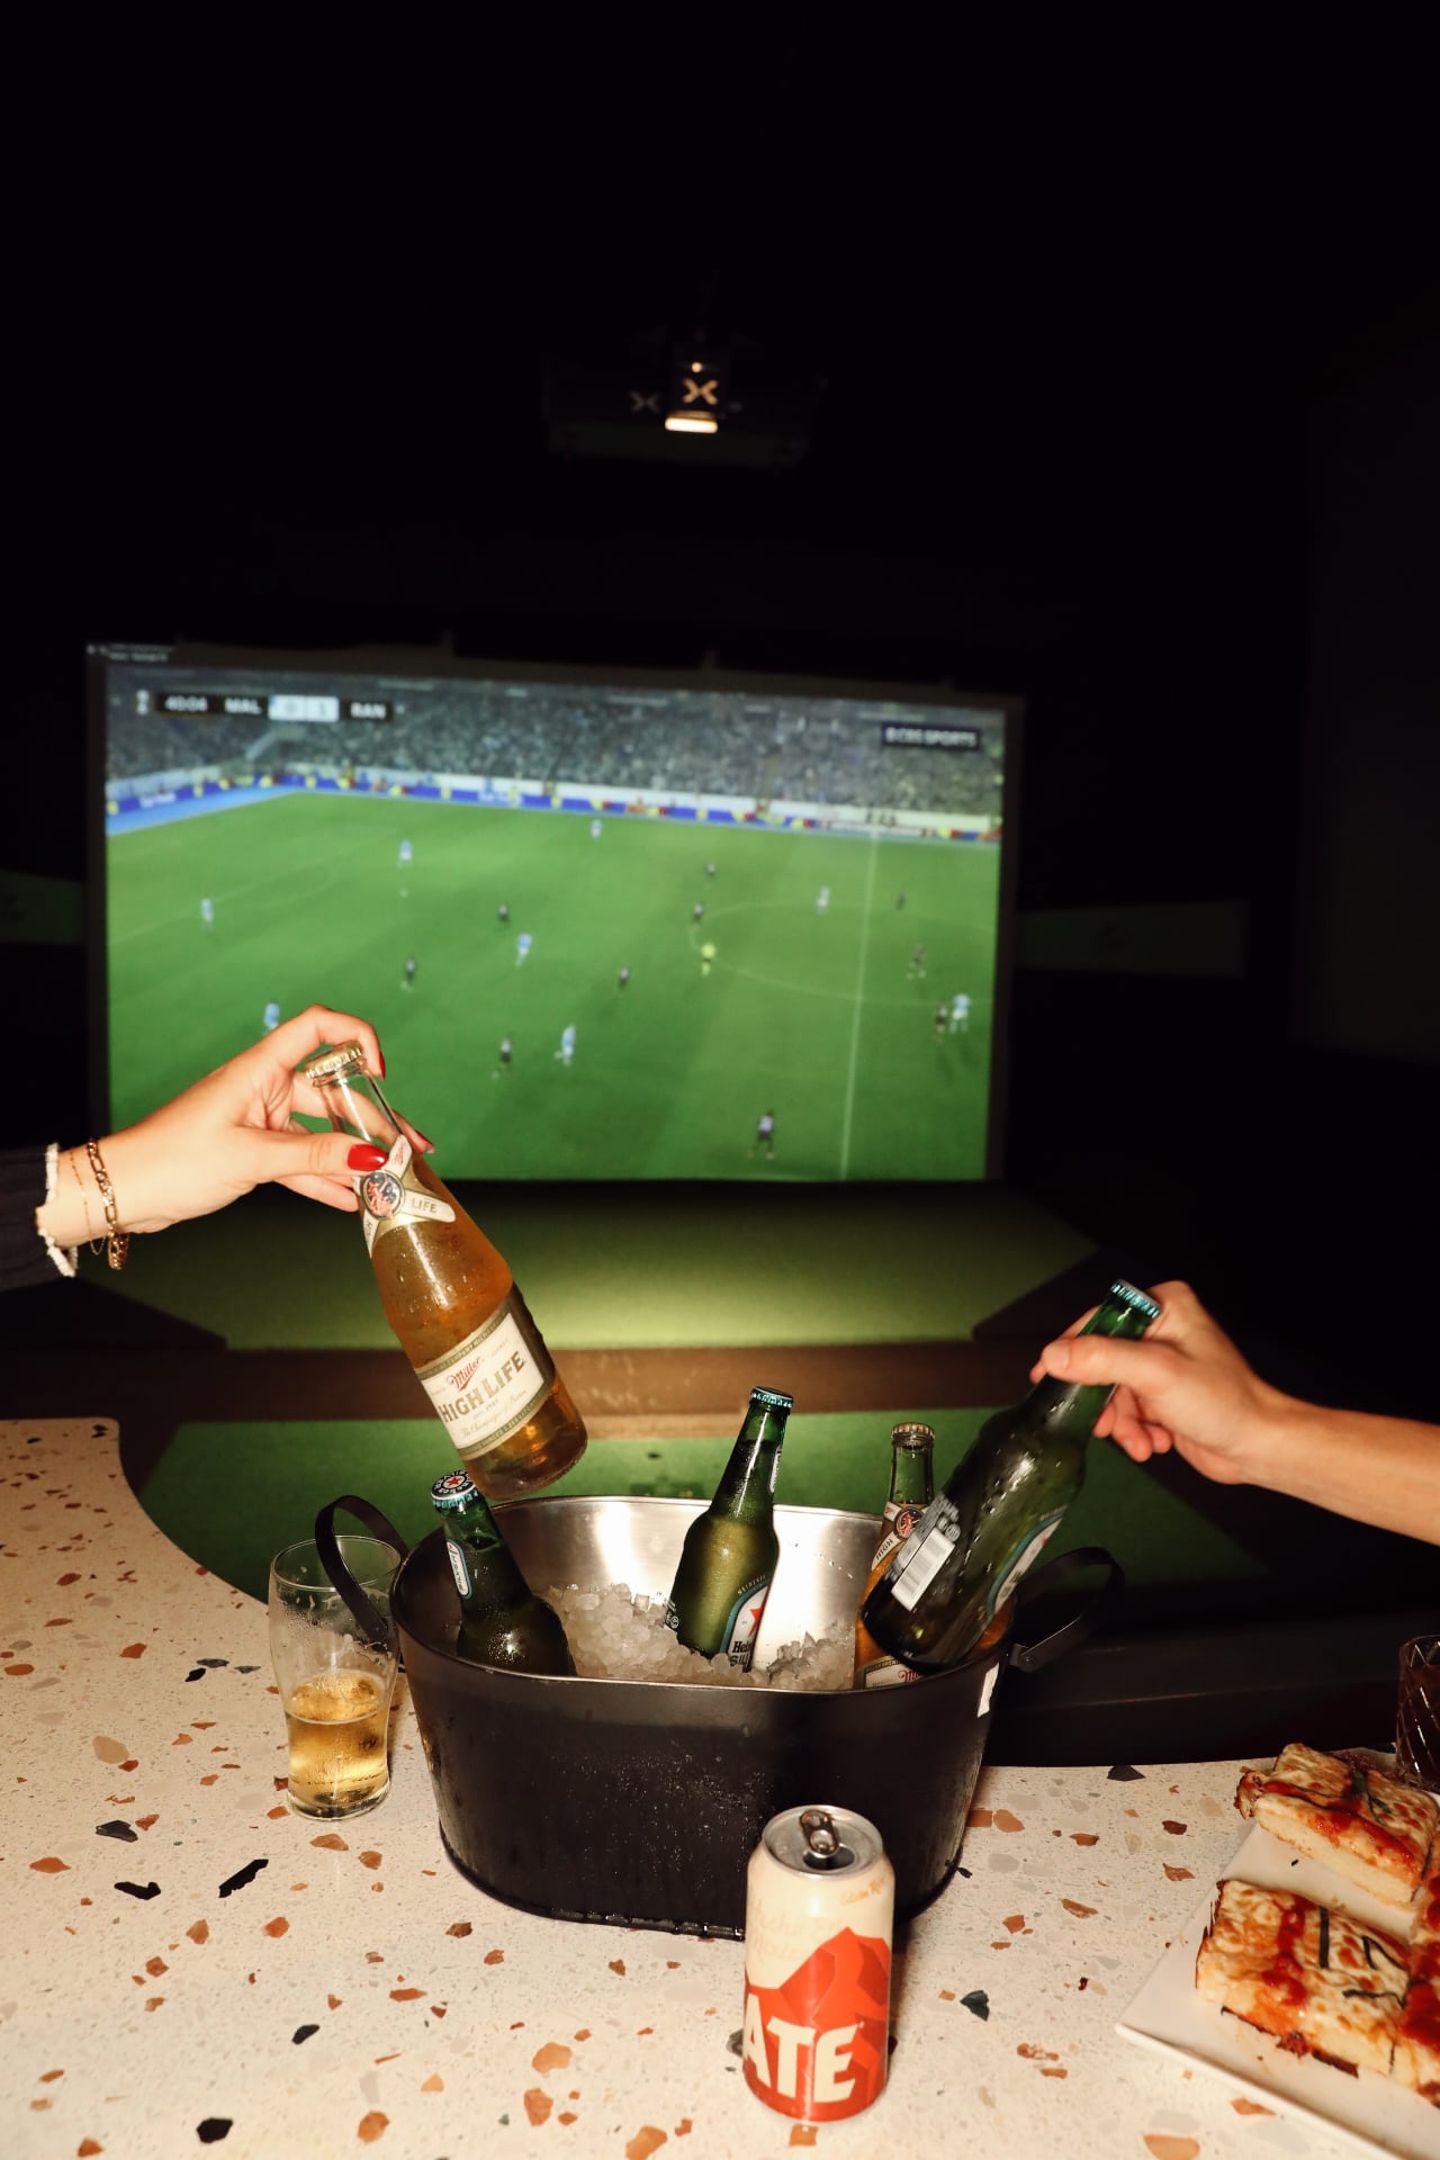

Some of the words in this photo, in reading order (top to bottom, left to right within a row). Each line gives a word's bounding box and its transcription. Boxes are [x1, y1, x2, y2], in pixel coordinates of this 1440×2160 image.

[412, 1198, 437, 1213] LIFE
[438, 1388, 484, 1423] HIGH
[481, 1351, 524, 1398] LIFE
[446, 1357, 481, 1391] Miller
[875, 1538, 893, 1560] HIGH
